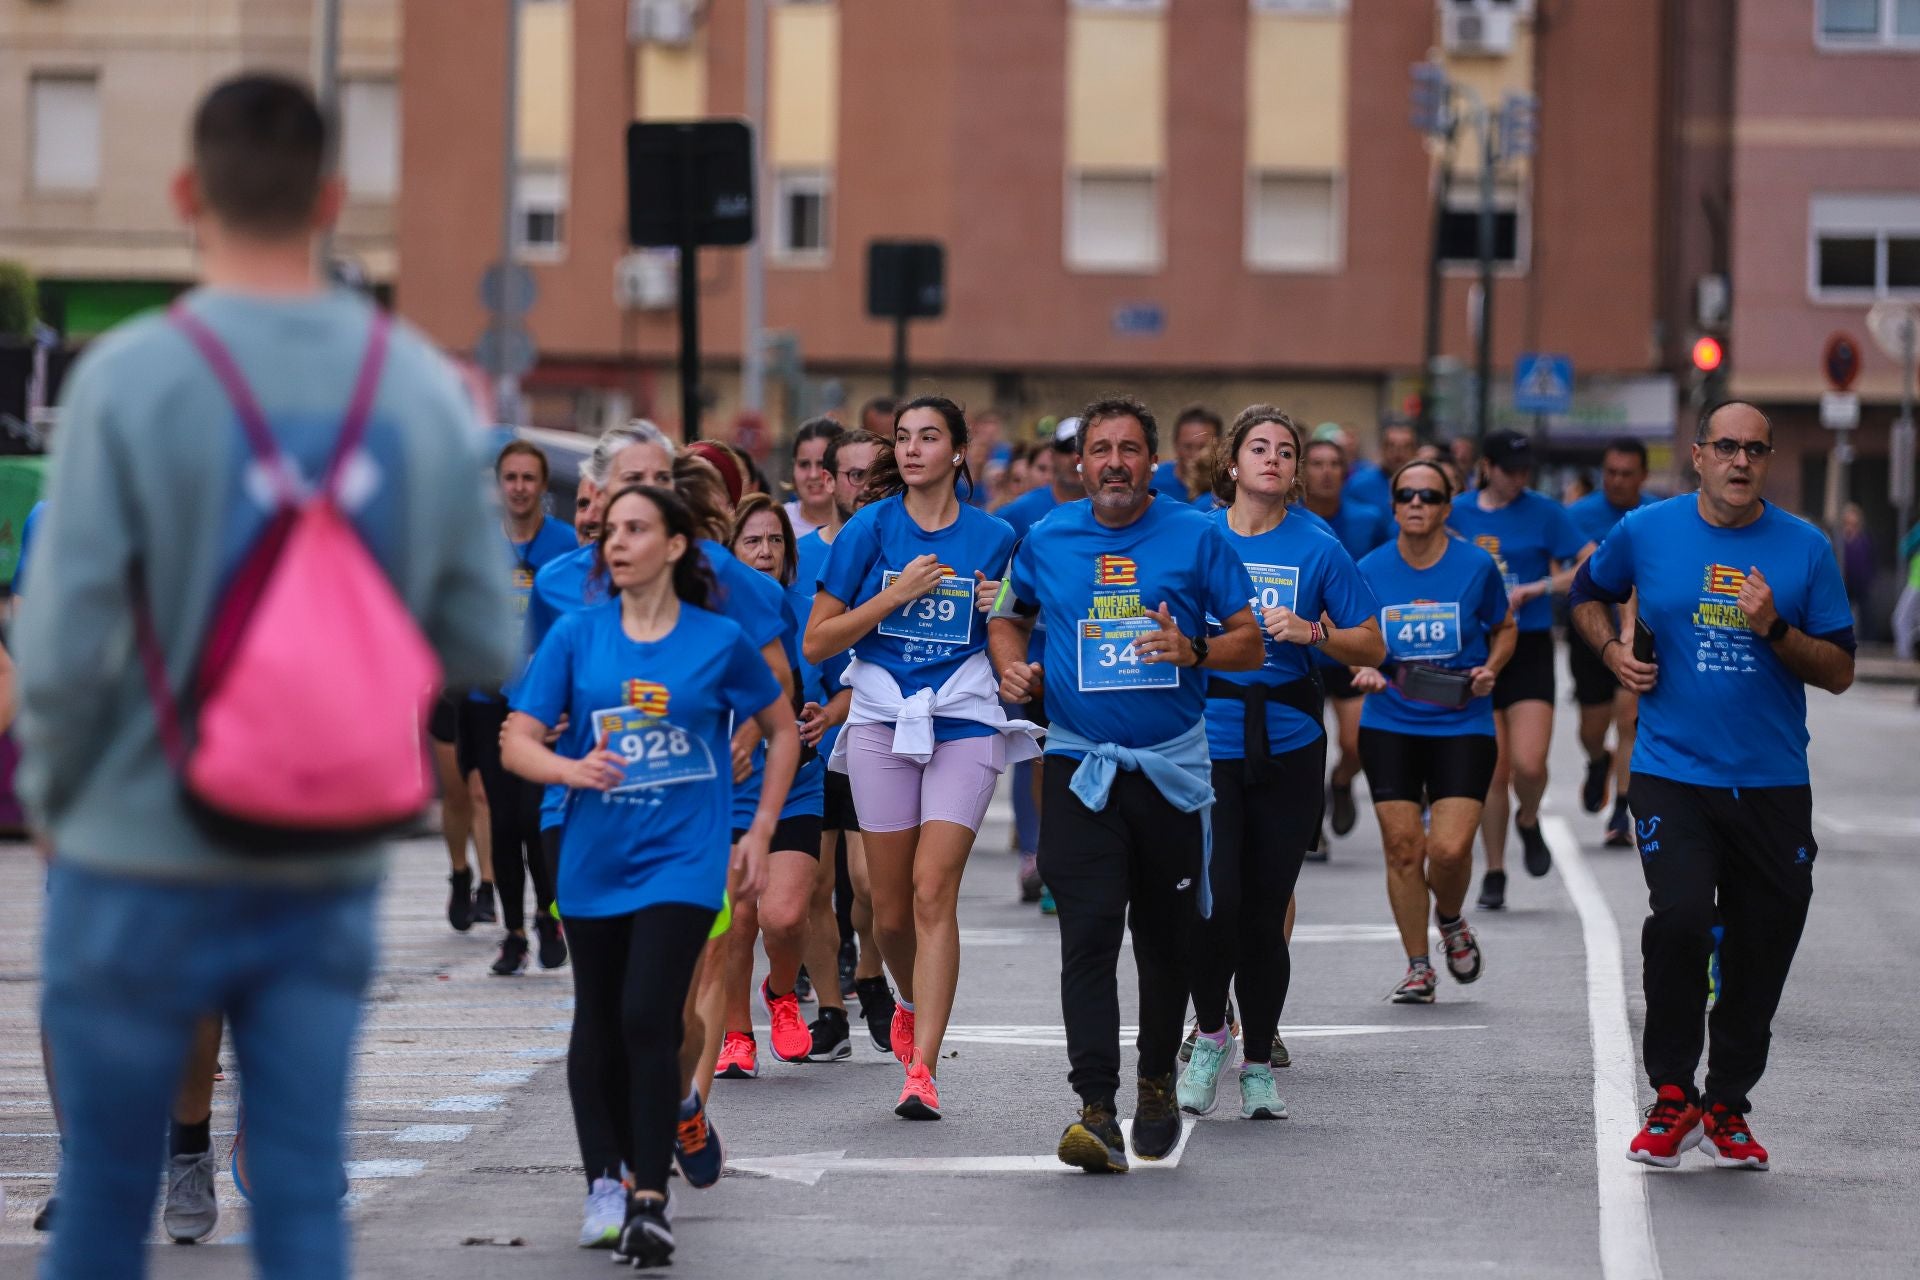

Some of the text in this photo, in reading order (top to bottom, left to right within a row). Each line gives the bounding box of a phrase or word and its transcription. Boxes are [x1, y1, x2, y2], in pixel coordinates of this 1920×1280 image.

[1264, 577, 1293, 586] VALENCIA
[941, 588, 970, 598] VALENCIA
[1093, 593, 1140, 608] MUÉVETE
[902, 597, 955, 621] 739
[1088, 608, 1096, 620] X
[1693, 612, 1700, 625] X
[1397, 621, 1446, 643] 418
[620, 731, 690, 763] 928
